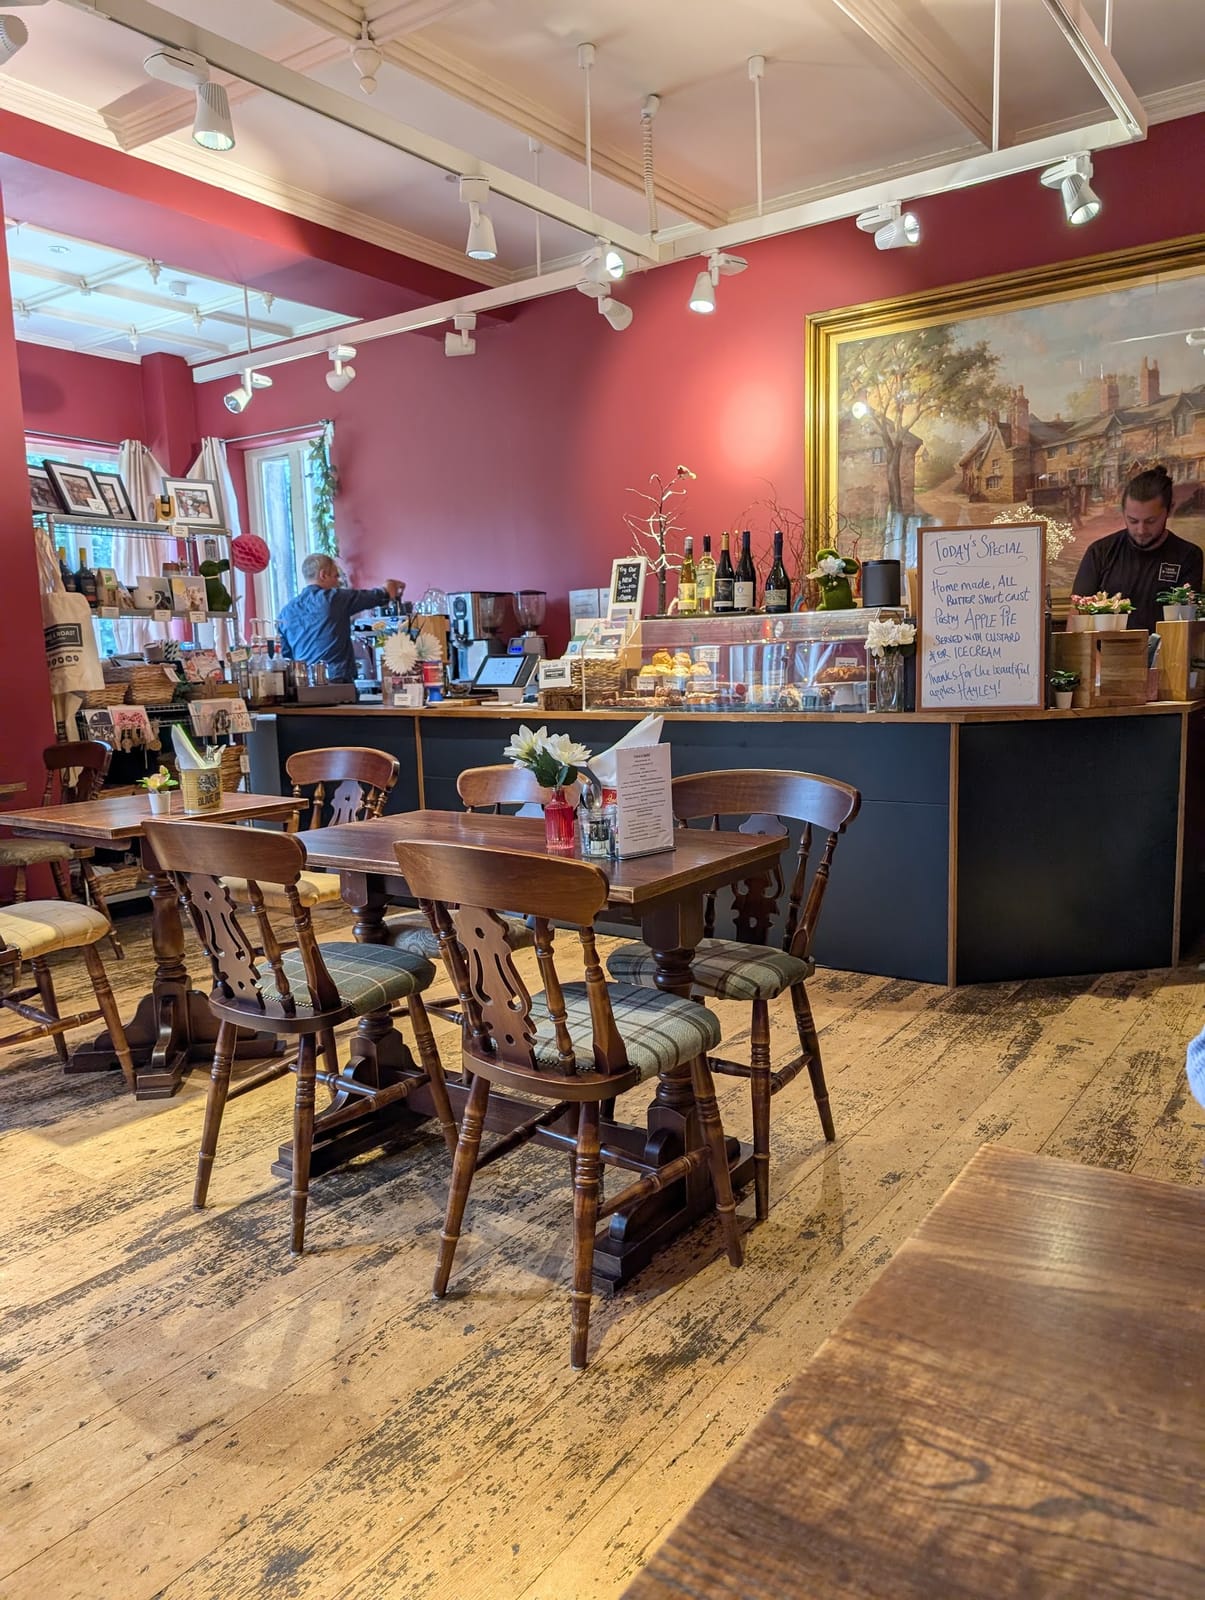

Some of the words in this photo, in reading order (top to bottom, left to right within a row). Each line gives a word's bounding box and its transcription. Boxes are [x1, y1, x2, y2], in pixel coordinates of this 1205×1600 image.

[977, 534, 1024, 558] SPECIAL
[998, 574, 1018, 587] ALL
[934, 607, 960, 630] Pastry
[964, 607, 997, 630] APPLE
[935, 634, 963, 645] SERVED
[985, 632, 1021, 642] CUSTARD
[927, 669, 958, 685] Thanks
[958, 663, 972, 680] for
[974, 663, 990, 677] the
[992, 662, 1030, 680] beautiful
[929, 685, 956, 700] apples
[957, 680, 1001, 701] HAYLEY!
